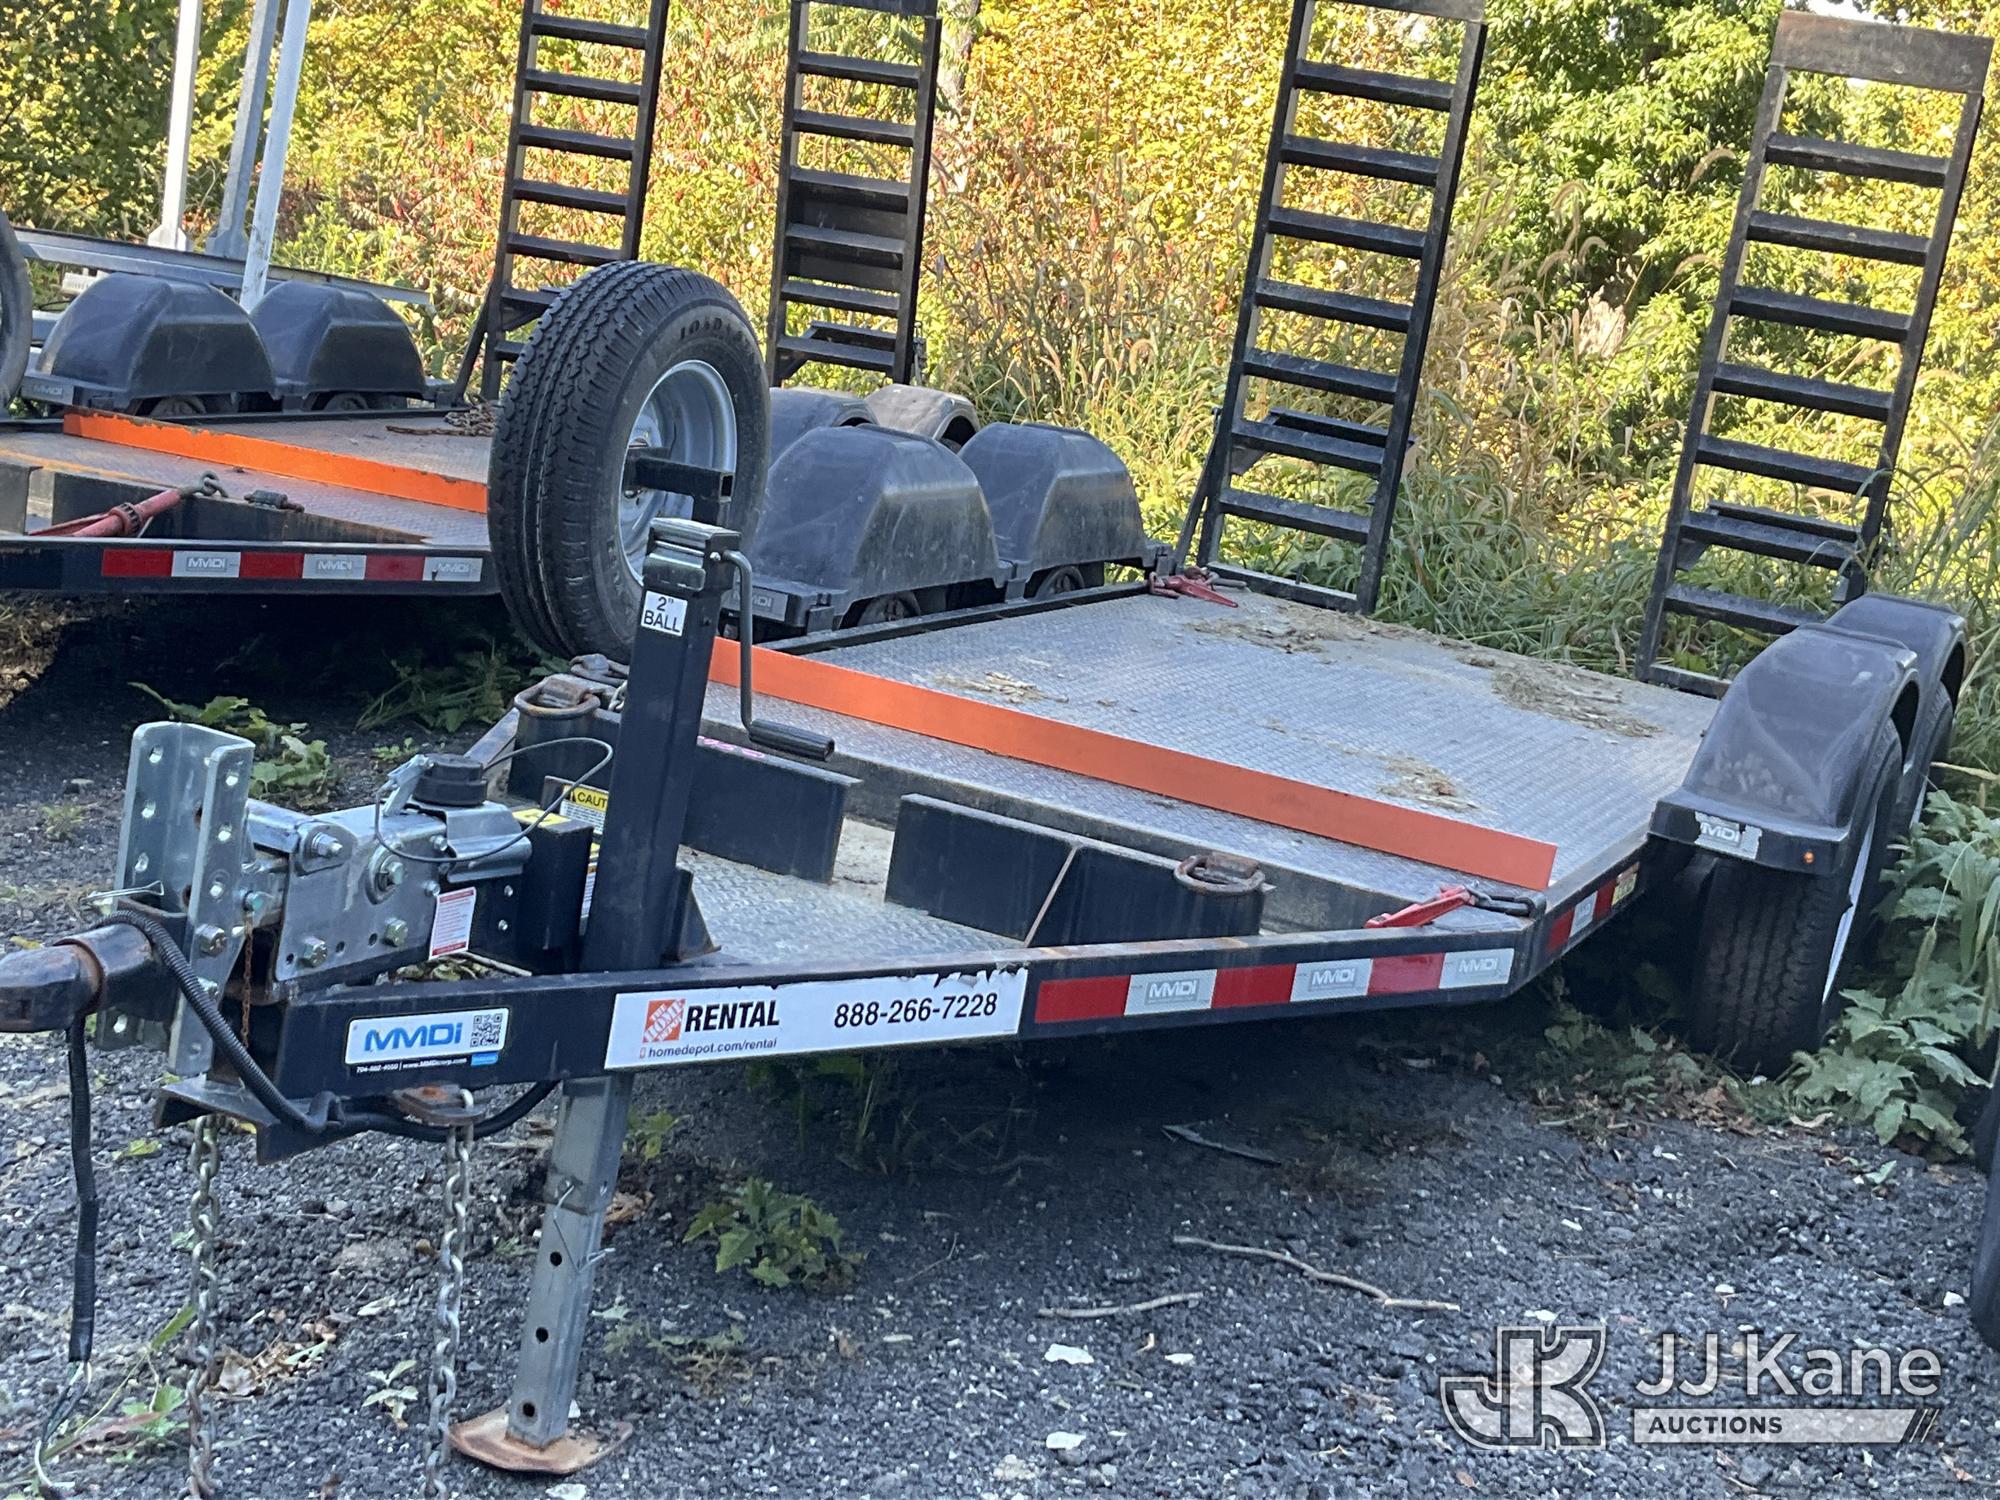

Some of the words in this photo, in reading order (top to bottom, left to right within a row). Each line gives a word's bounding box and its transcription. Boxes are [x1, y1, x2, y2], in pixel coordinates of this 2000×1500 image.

[643, 609, 681, 633] BALL
[577, 791, 608, 808] CAUT
[1700, 821, 1740, 843] MDI
[642, 999, 684, 1042] HOME
[684, 1000, 780, 1033] RENTAL
[833, 991, 999, 1029] 888-266-7228
[647, 1037, 778, 1059] homedepot.com/rental
